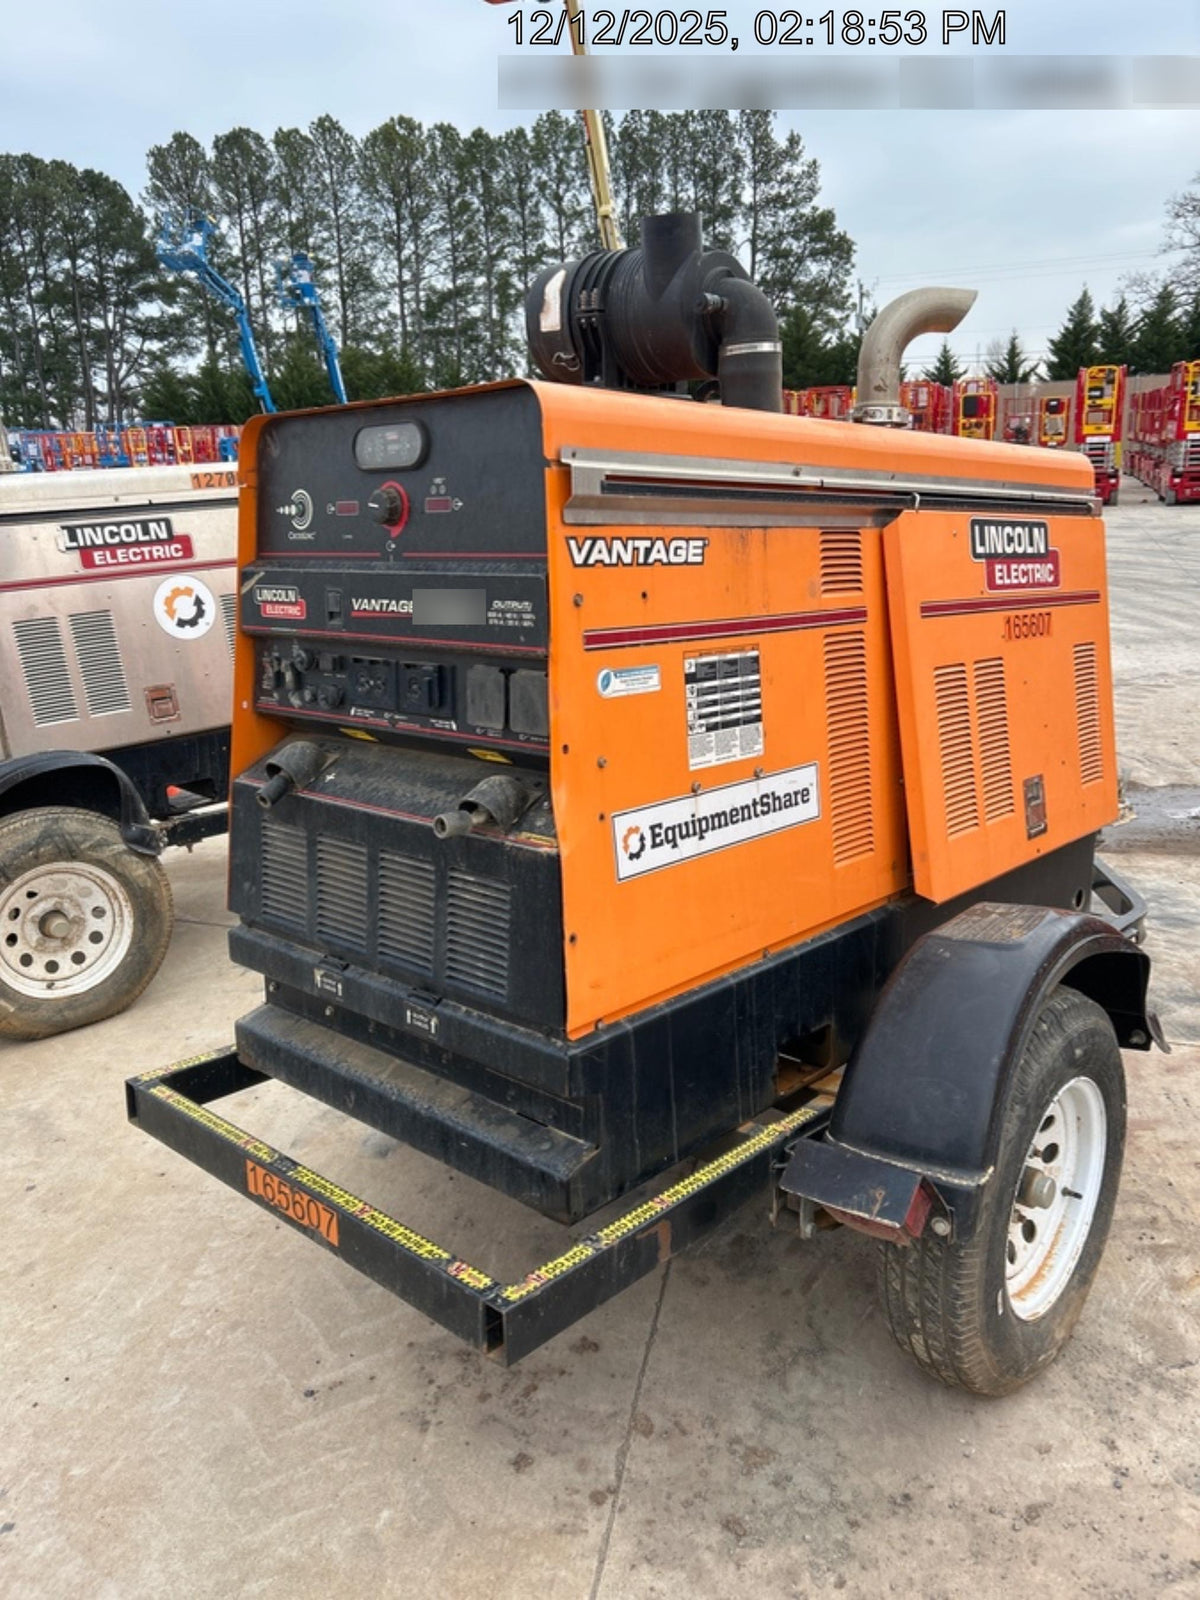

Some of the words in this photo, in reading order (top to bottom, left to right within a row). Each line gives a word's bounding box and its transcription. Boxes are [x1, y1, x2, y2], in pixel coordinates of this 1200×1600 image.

[62, 520, 169, 546] LINCOLN
[974, 524, 1046, 555] LINCOLN
[93, 544, 184, 565] ELECTRIC
[567, 537, 706, 567] VANTAGE
[994, 562, 1055, 585] ELECTRIC
[256, 588, 296, 604] LINCOLN
[265, 604, 302, 616] ELECTRIC
[1006, 612, 1051, 640] 165607
[649, 787, 811, 850] EquipmentShare
[249, 1164, 335, 1238] 165607
[544, 1259, 565, 1276] DO
